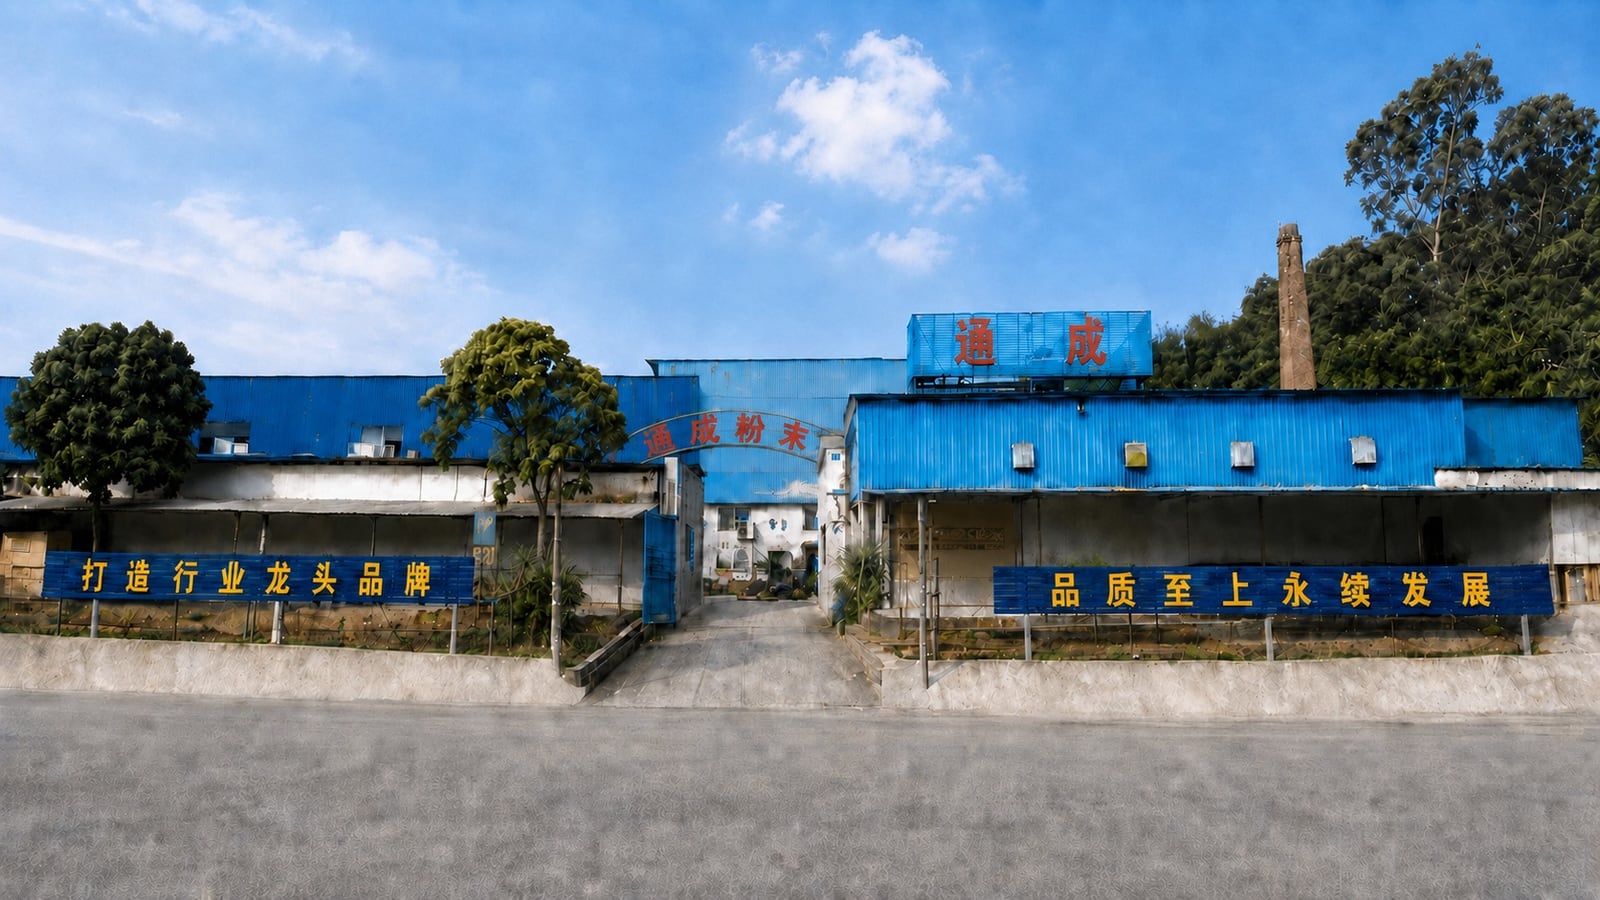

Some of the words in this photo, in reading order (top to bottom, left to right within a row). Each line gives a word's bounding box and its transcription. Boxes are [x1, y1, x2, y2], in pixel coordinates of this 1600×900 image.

[954, 316, 1107, 367] 通成
[643, 412, 810, 457] 通成粉末
[81, 558, 431, 597] 打造行业龙头品牌
[1050, 570, 1492, 608] 品质至上永续发展
